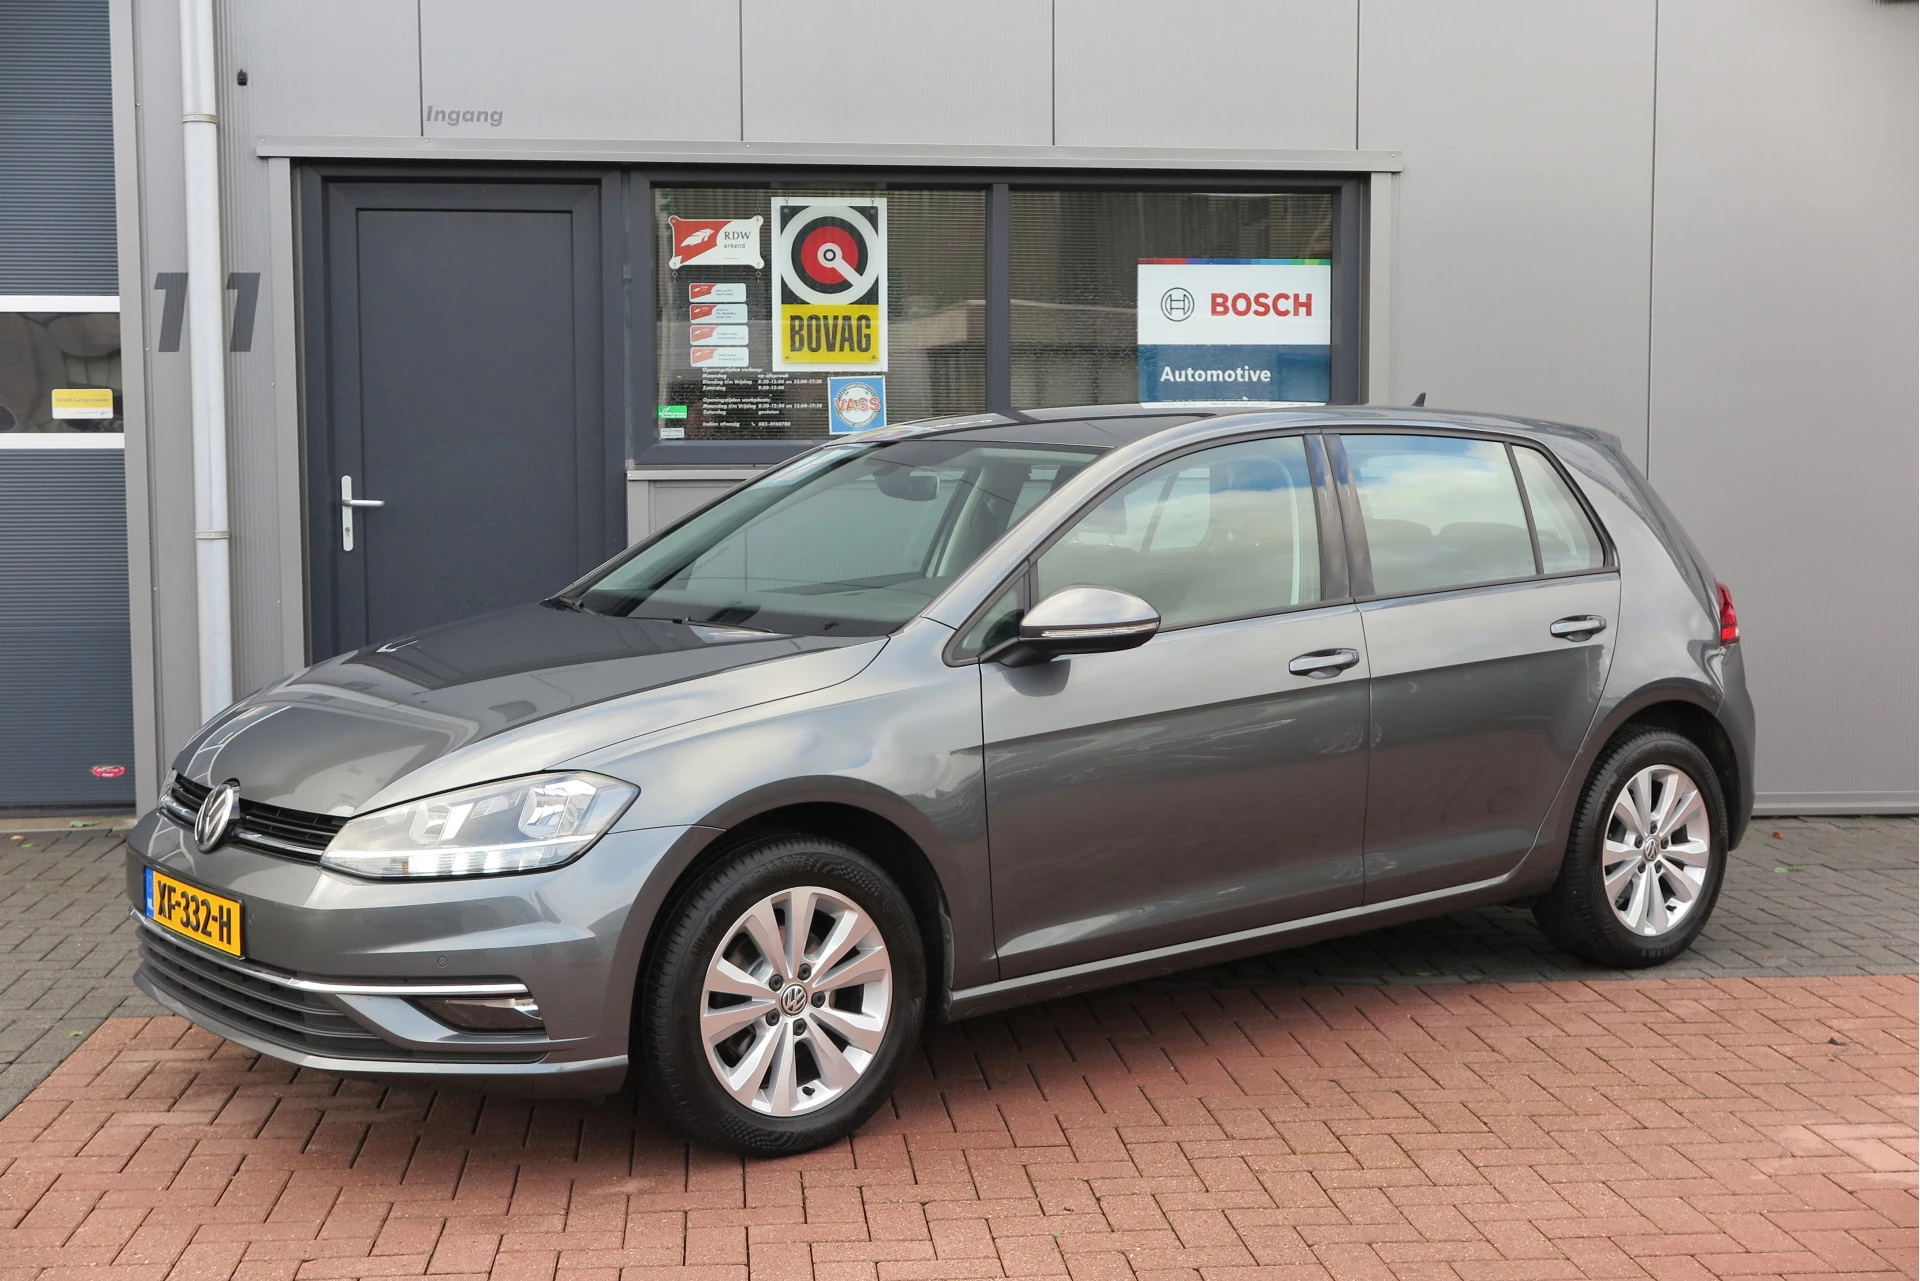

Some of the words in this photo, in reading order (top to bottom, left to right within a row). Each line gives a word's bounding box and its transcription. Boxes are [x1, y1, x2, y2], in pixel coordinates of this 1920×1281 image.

[426, 105, 504, 127] Ingang
[724, 231, 751, 240] RDW
[1210, 292, 1313, 317] BOSCH
[790, 314, 872, 353] BOVAG
[1160, 365, 1272, 382] Automotive
[834, 396, 881, 413] VASS
[157, 880, 232, 946] XF-332-H
